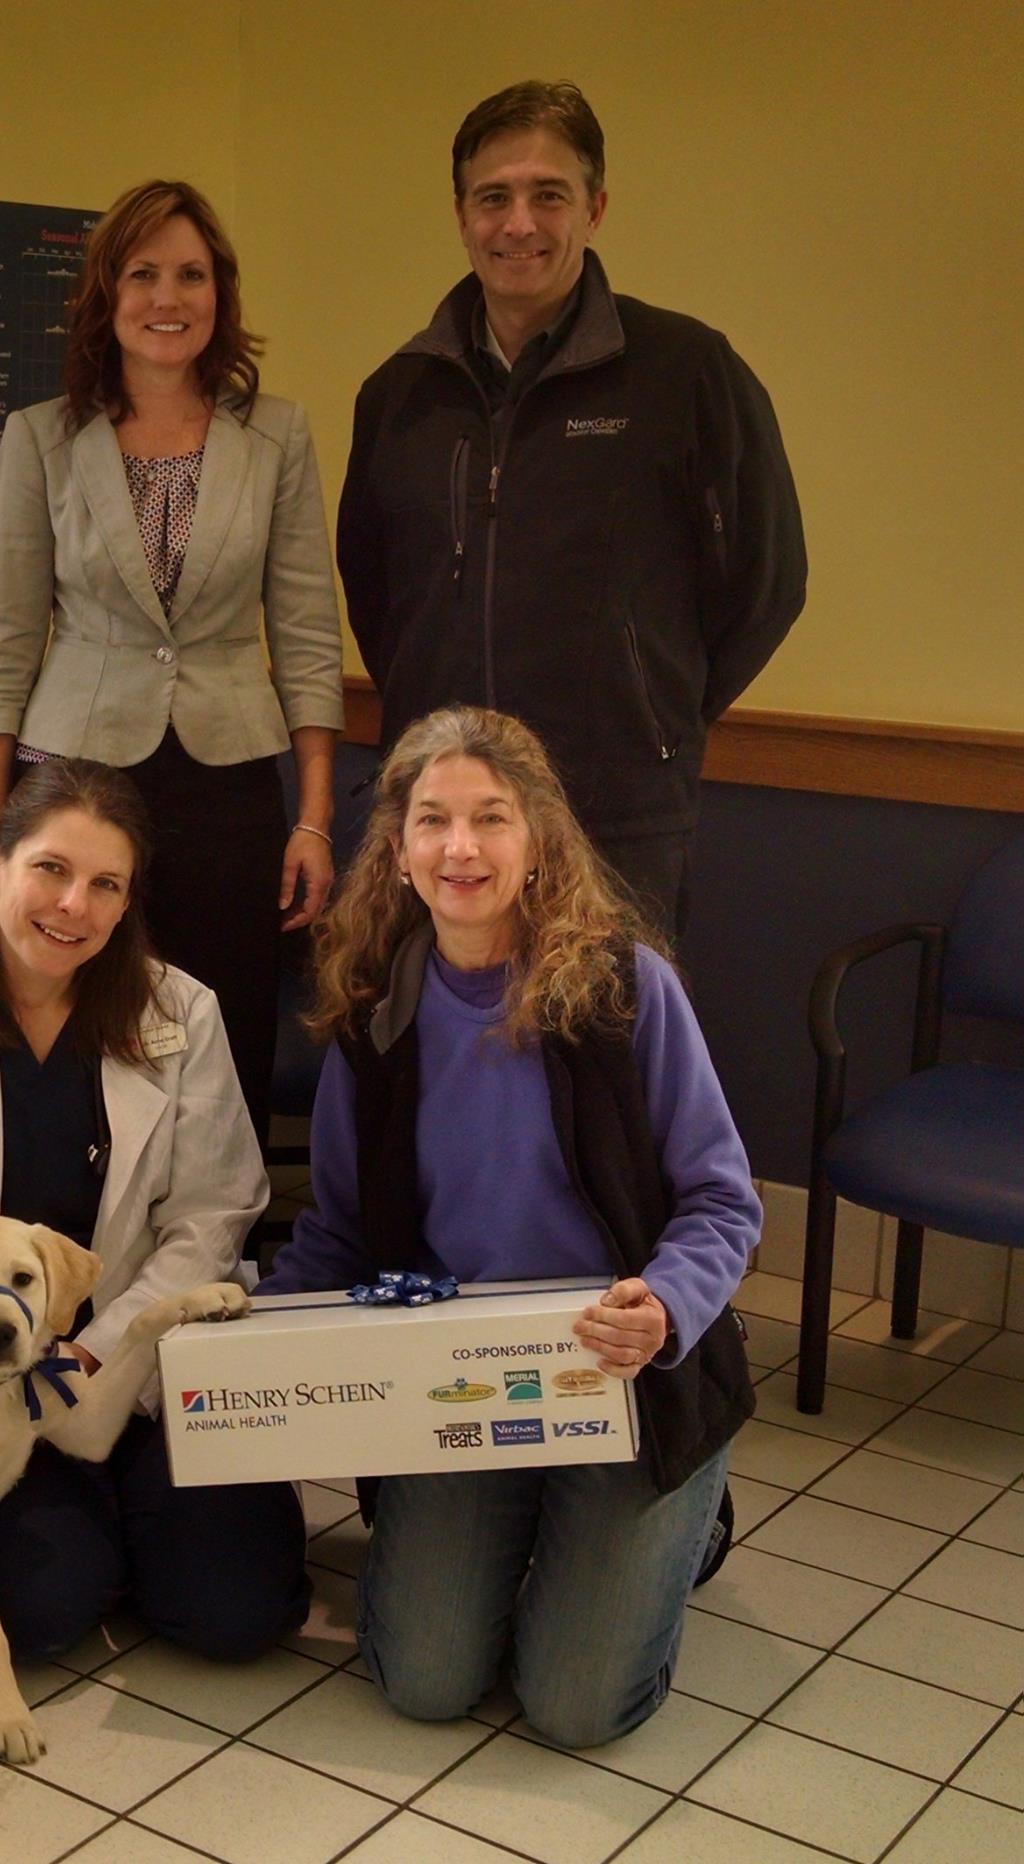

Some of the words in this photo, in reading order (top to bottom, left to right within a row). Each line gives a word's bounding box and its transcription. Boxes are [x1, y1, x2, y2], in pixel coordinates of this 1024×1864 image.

[452, 1343, 553, 1361] CO-SPONSORED
[556, 1341, 578, 1353] BY:
[505, 1373, 539, 1383] MERIAL
[206, 1388, 290, 1411] HENRY
[185, 1418, 235, 1432] ANIMAL
[239, 1414, 287, 1429] HEALTH
[494, 1424, 540, 1434] Virbac
[433, 1430, 483, 1449] Treats
